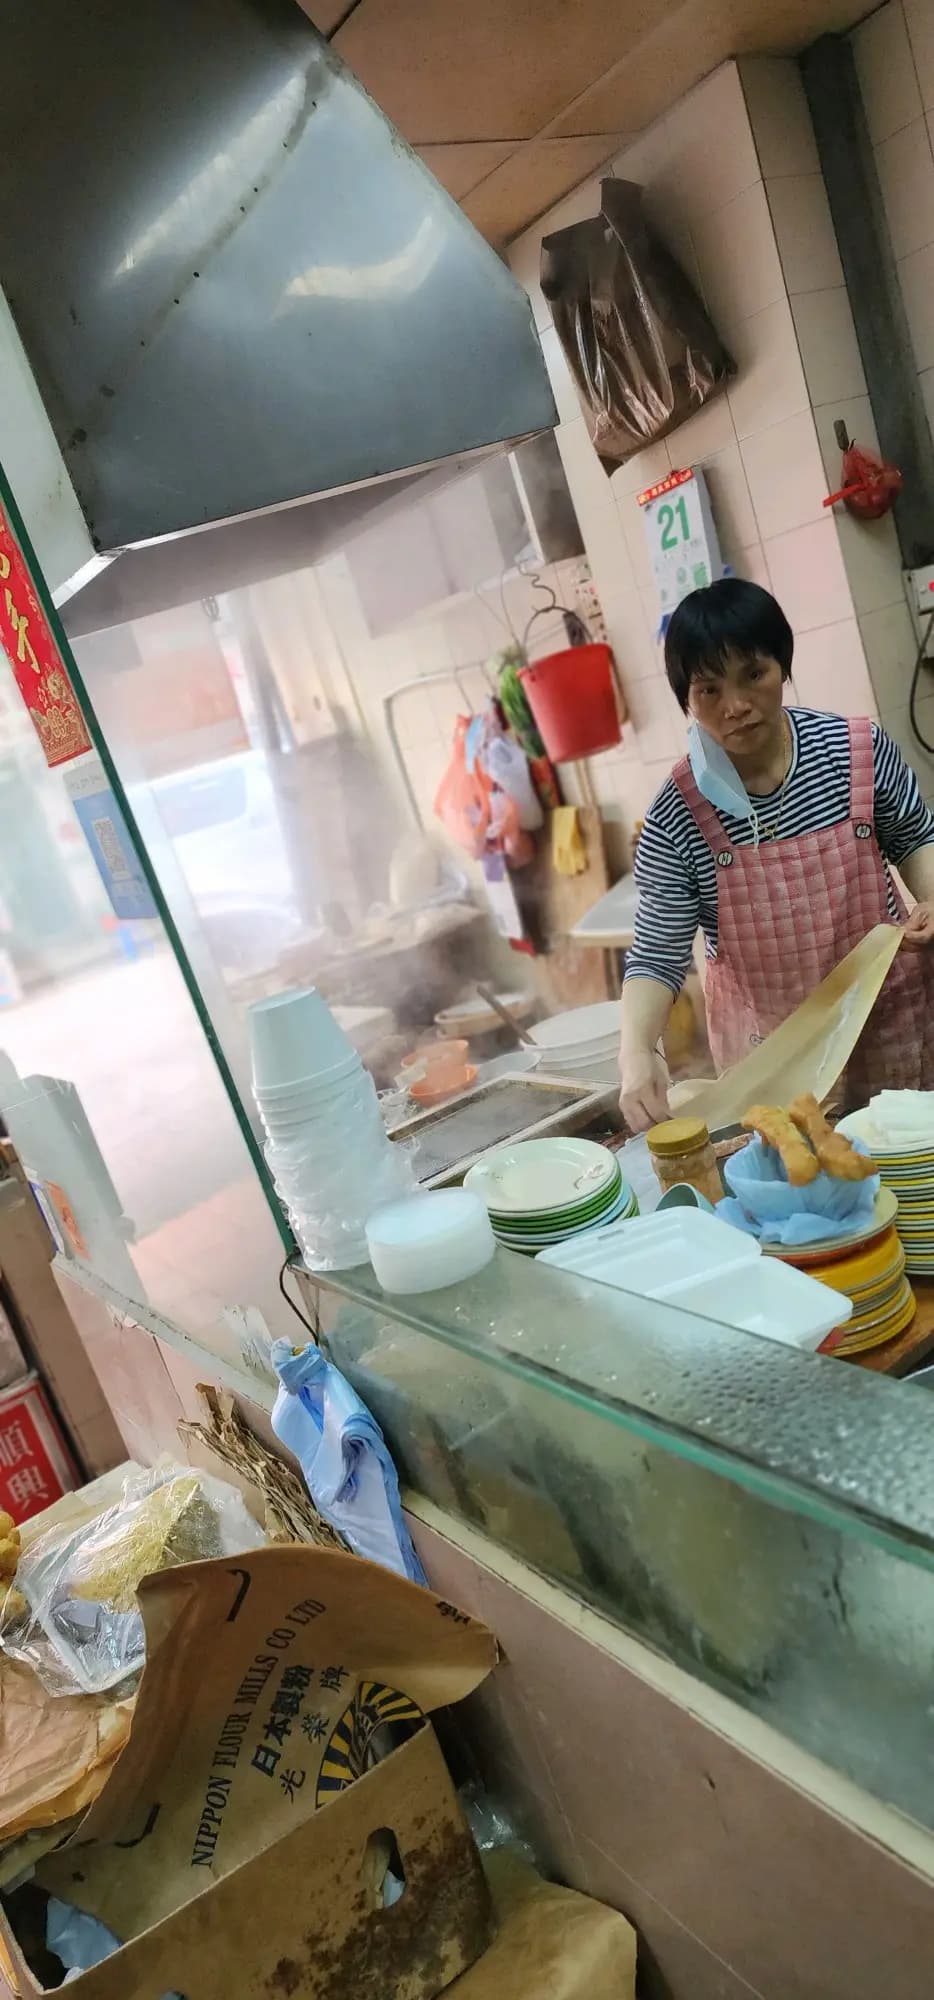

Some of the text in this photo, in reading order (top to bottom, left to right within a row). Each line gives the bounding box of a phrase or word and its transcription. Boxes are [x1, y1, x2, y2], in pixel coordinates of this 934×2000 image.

[657, 495, 690, 552] 21
[191, 1598, 326, 1868] NIPPON FLOUR MILLS CO LTD
[250, 1664, 315, 1777] 日本製粉
